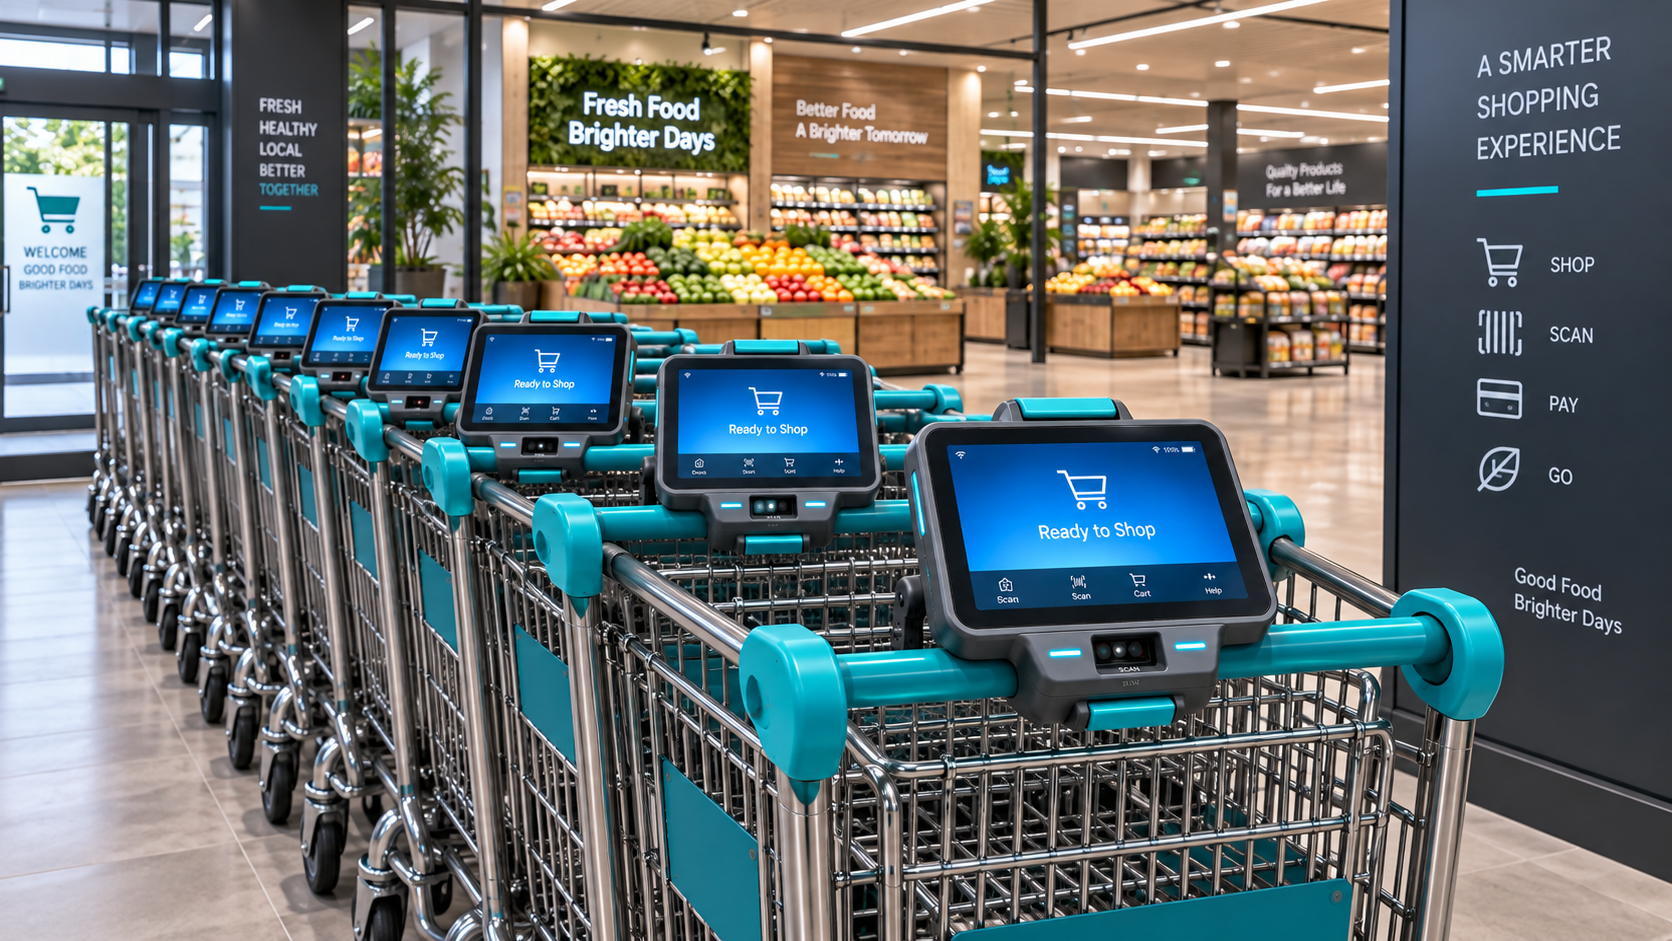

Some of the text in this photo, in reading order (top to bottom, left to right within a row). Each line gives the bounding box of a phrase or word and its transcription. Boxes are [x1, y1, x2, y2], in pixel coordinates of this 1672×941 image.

[1477, 36, 1611, 78] A SMARTER
[259, 97, 302, 114] FRESH
[583, 91, 700, 121] Fresh Food
[1477, 82, 1599, 119] SHOPPING
[796, 99, 876, 121] Better Food
[259, 120, 318, 137] HEALTHY
[795, 122, 928, 145] A Brighter Tomorrow
[568, 120, 715, 155] Brighter Days
[1477, 124, 1621, 160] EXPERIENCE
[259, 141, 303, 157] LOCAL
[259, 163, 306, 178] BETTER
[1299, 161, 1343, 177] Products
[259, 182, 319, 196] TOGETHER
[1266, 179, 1346, 198] For a Better Life
[23, 246, 87, 258] WELCOME
[23, 264, 88, 275] GOOD FOOD
[1550, 256, 1595, 273] SHOP
[19, 280, 94, 290] BRIGHTER DAYS
[1550, 326, 1594, 343] SCAN
[429, 351, 444, 360] Shop
[514, 379, 575, 390] Ready to Shop
[1549, 395, 1579, 413] PAY
[728, 423, 808, 437] Ready to Shop
[1548, 467, 1573, 485] GO
[1038, 521, 1156, 542] Ready to Shop
[1204, 586, 1222, 596] Help
[1514, 566, 1602, 602] Good Food
[997, 594, 1019, 604] Scan
[1071, 591, 1091, 601] Scan
[1133, 589, 1151, 598] Cart
[1514, 593, 1622, 635] Brighter Days
